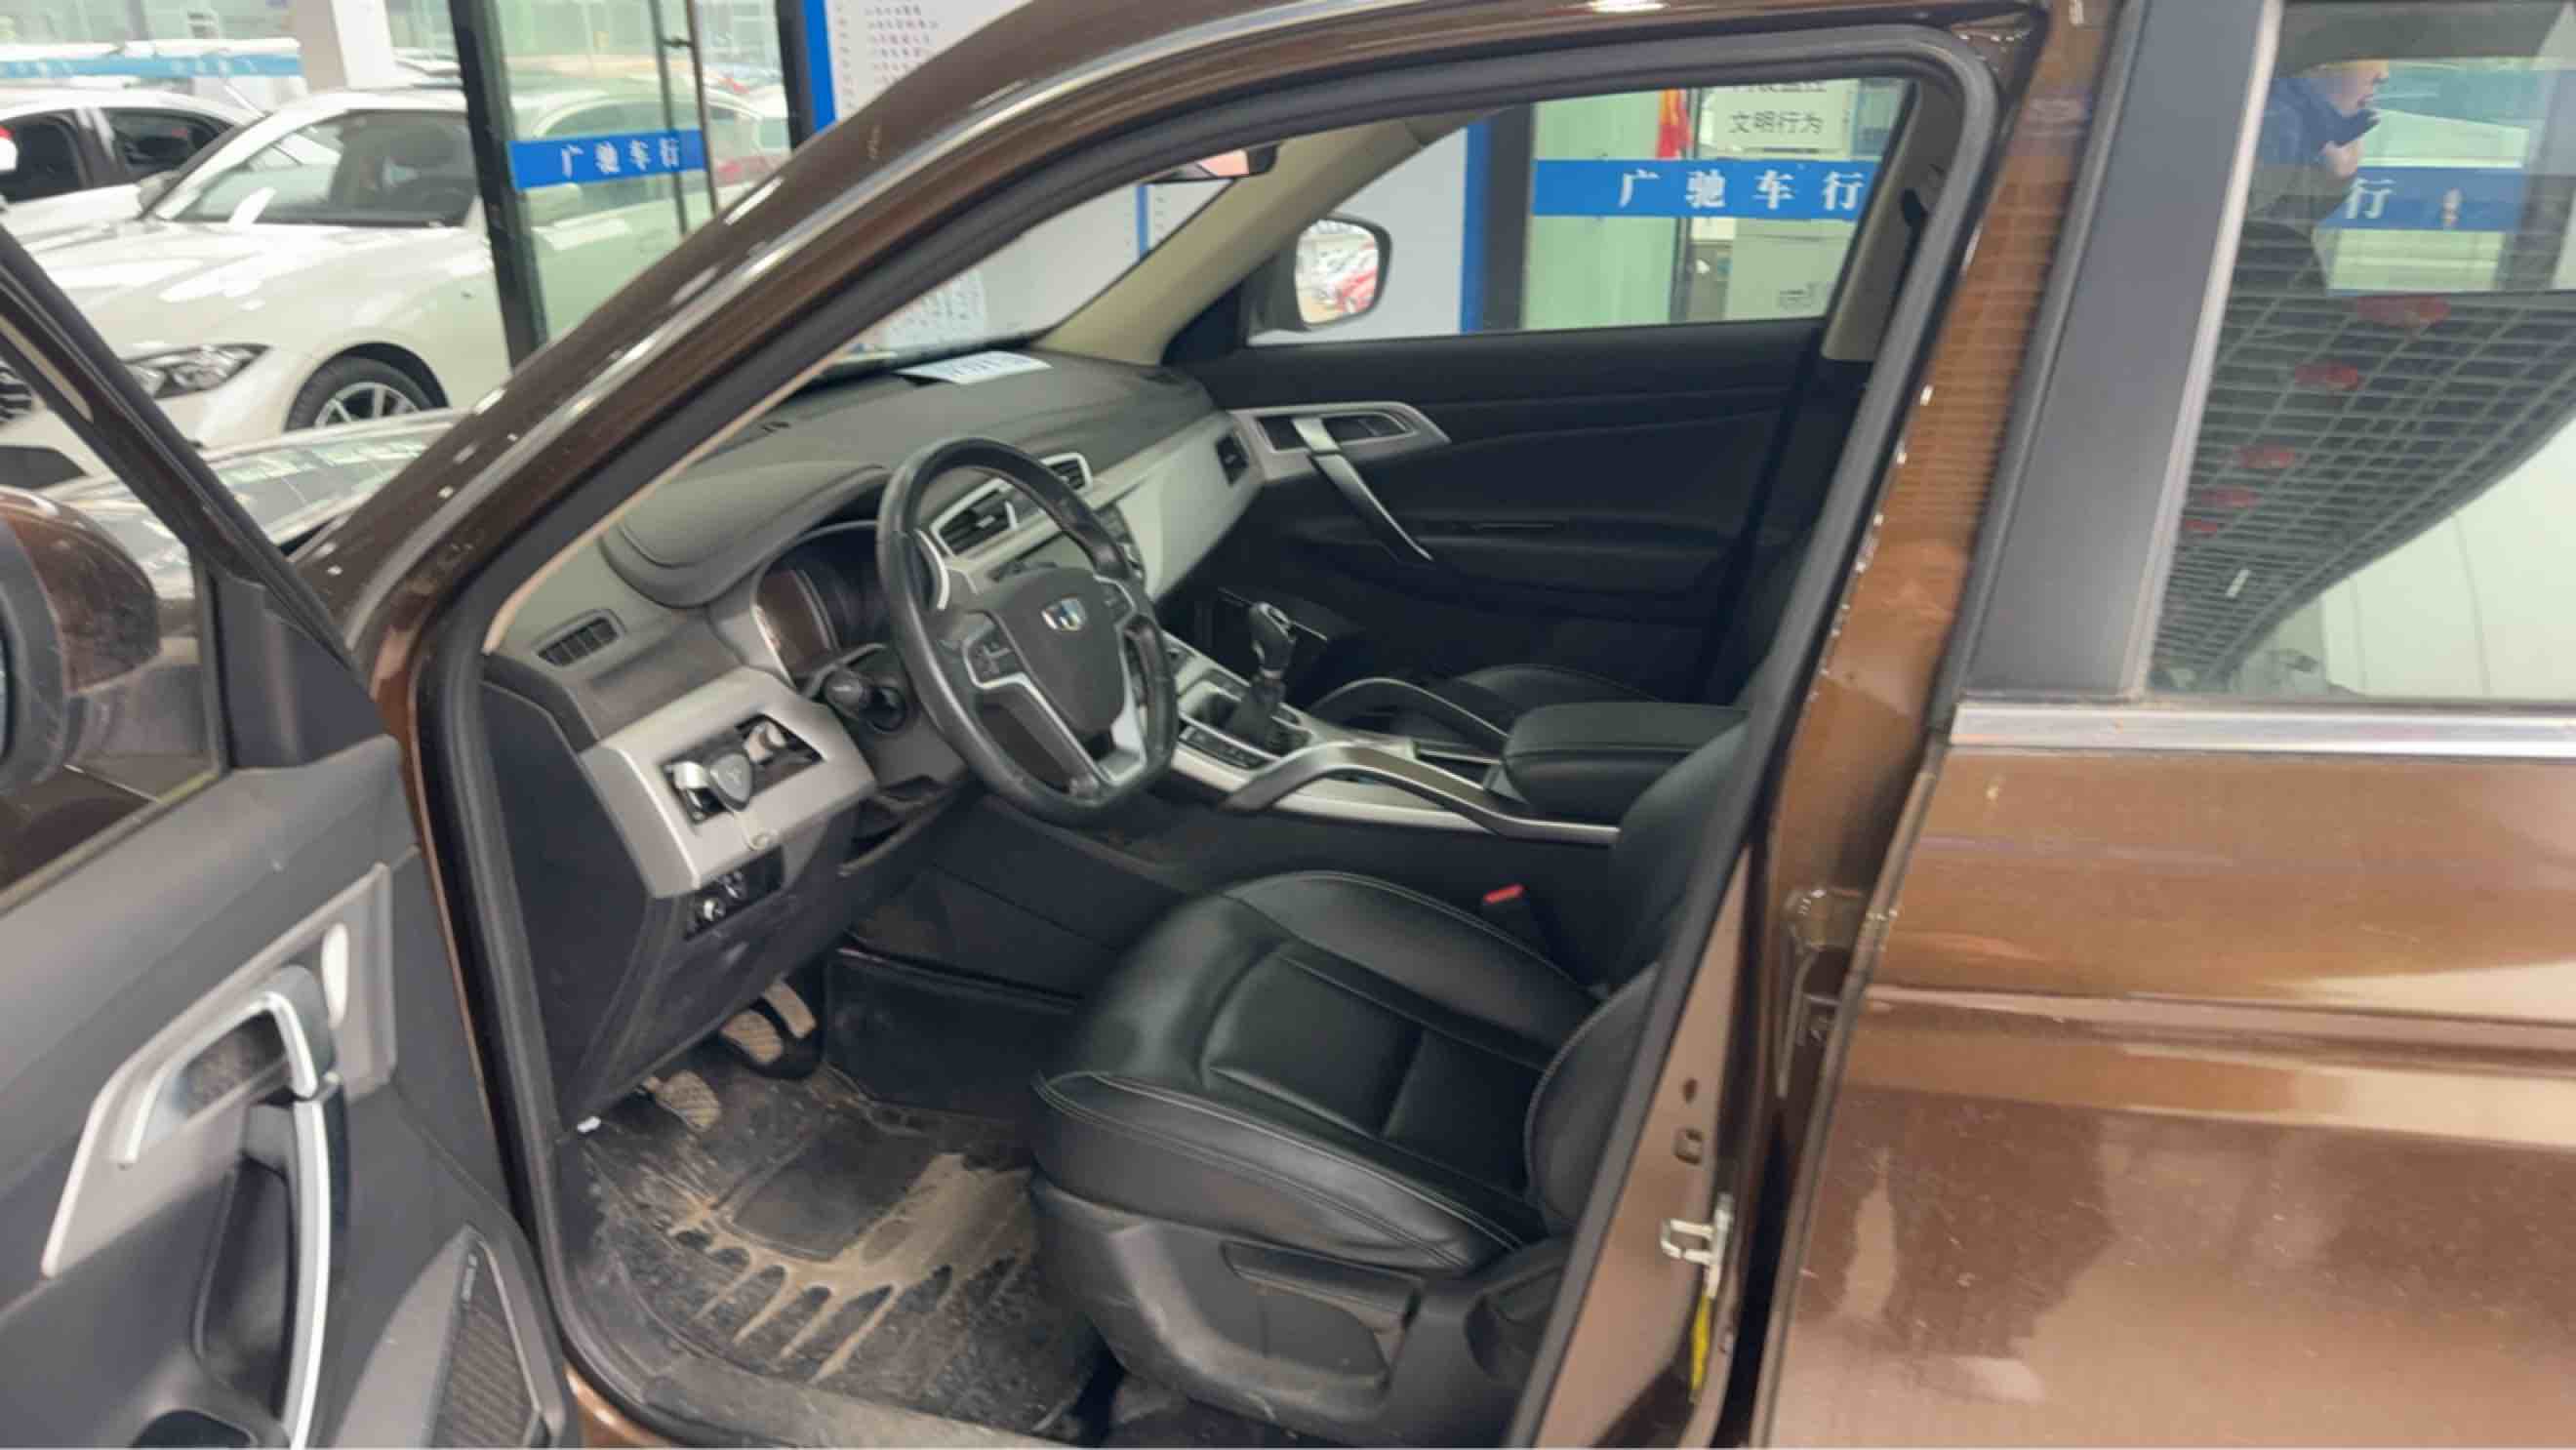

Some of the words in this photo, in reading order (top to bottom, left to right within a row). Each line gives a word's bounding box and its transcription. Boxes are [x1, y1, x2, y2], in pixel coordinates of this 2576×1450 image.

[1728, 109, 1824, 135] 文明行为
[1618, 169, 1864, 211] 广驰车行
